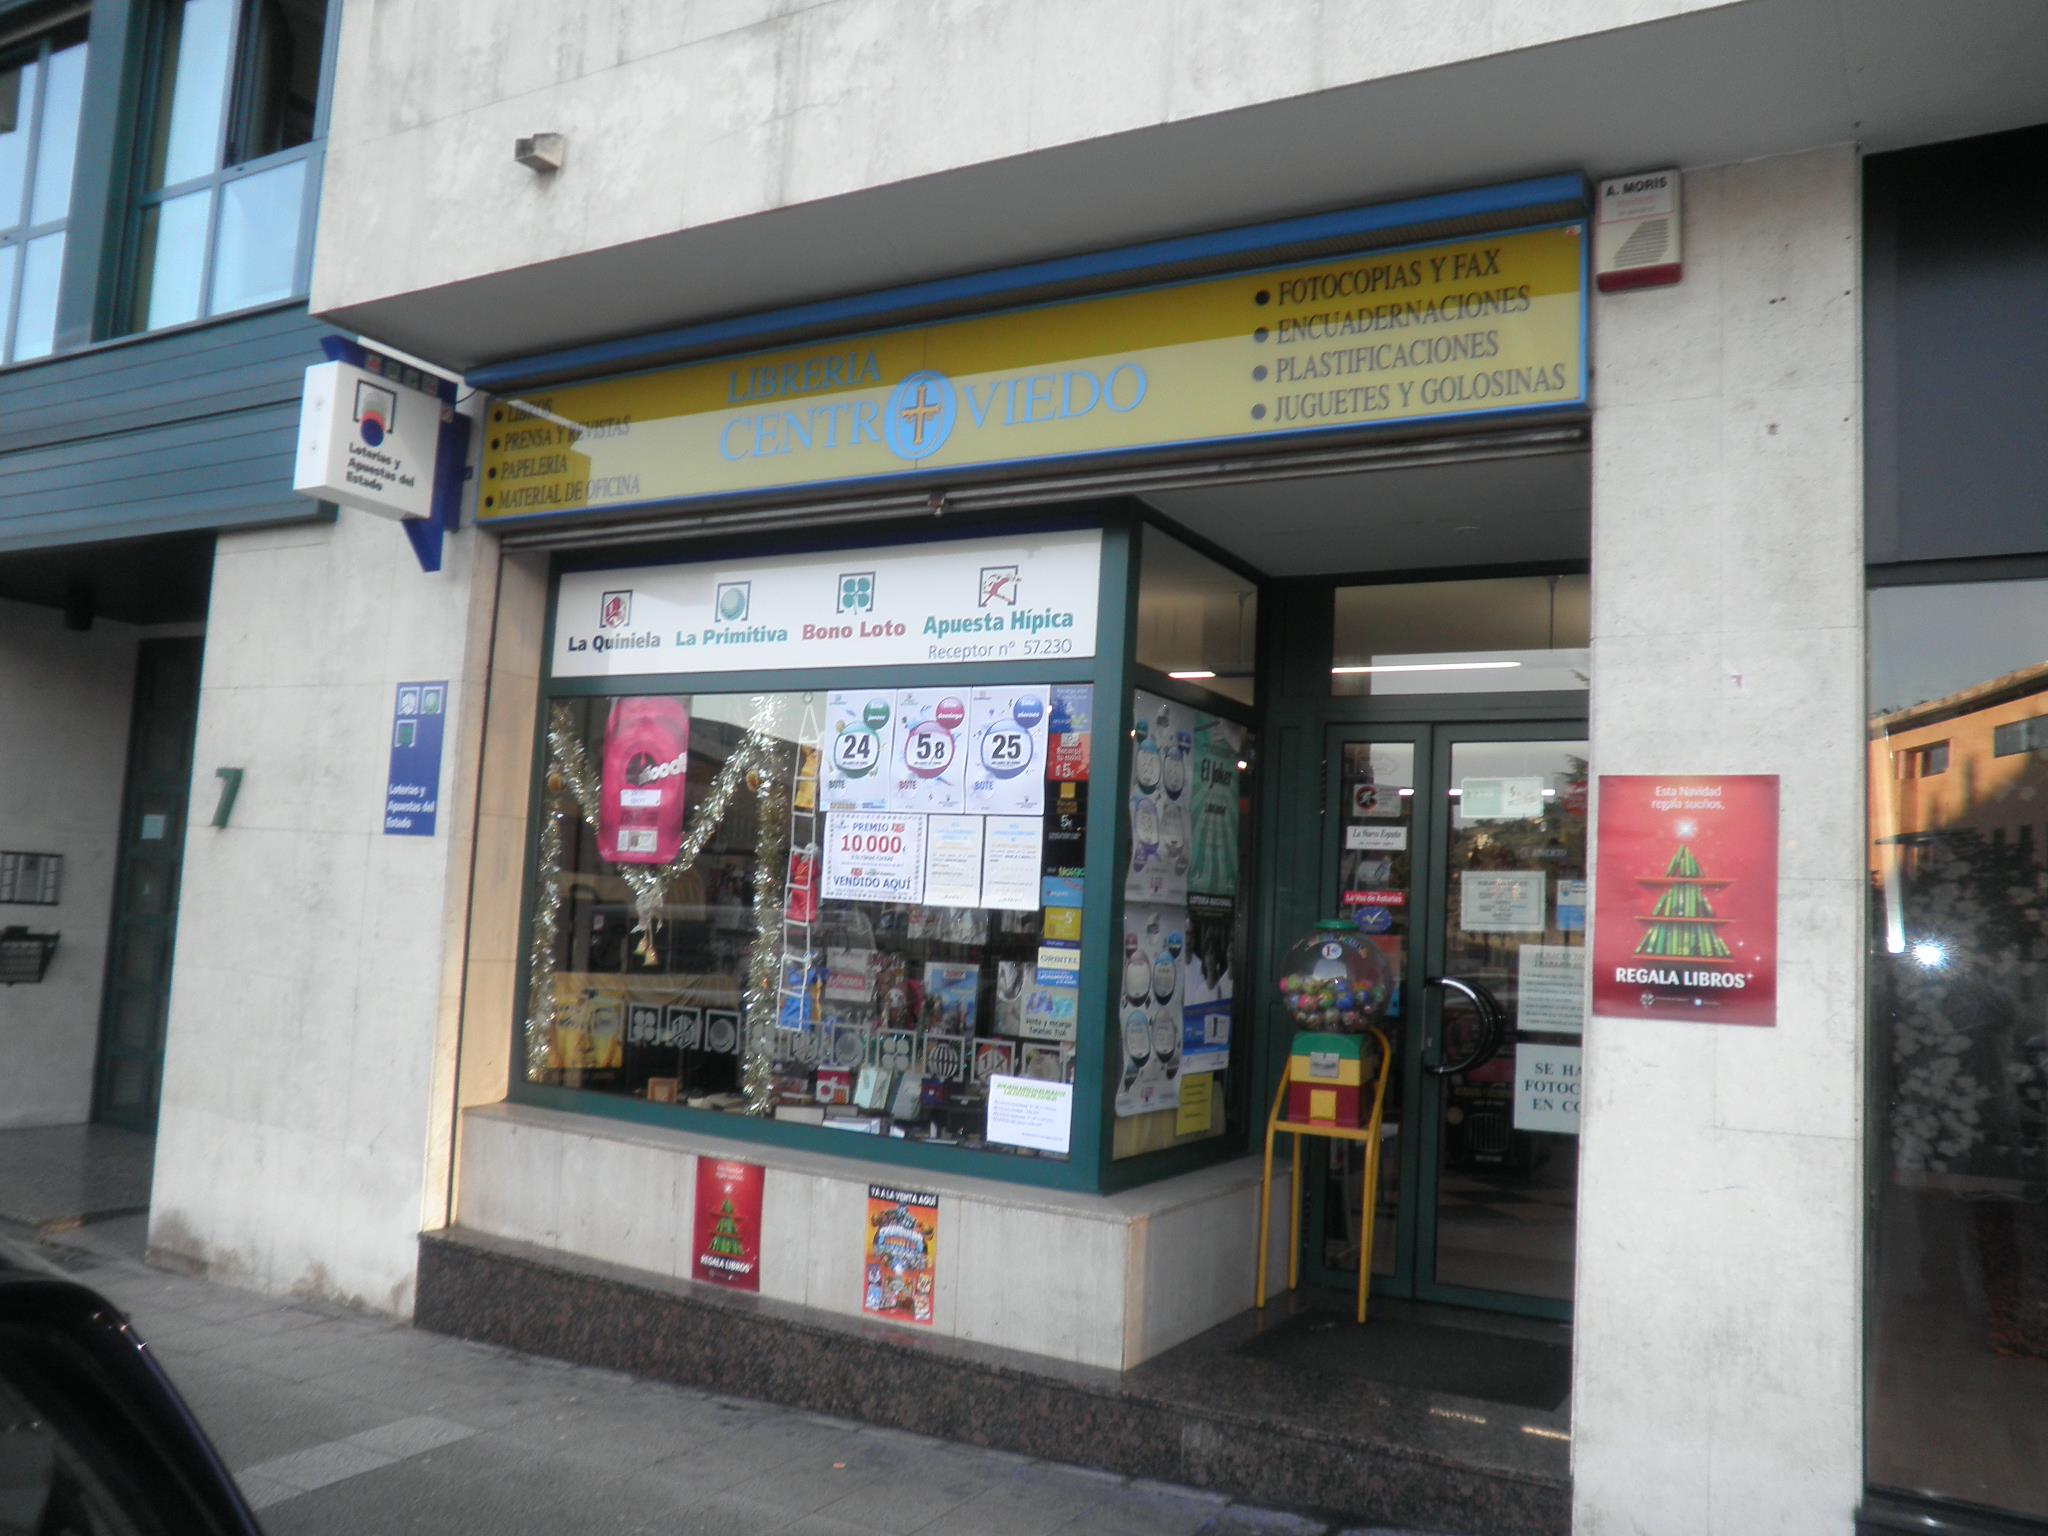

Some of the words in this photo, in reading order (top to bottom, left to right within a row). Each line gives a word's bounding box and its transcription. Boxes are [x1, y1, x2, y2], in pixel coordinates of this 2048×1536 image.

[1623, 176, 1668, 194] MORIS
[1278, 259, 1422, 307] FOTOCOPIAS
[1429, 257, 1448, 284] Y
[1452, 248, 1503, 281] FAX
[1277, 284, 1531, 345] ENCUADERNACIONES
[1275, 330, 1500, 383] PLASTIFICACIONES
[726, 350, 881, 404] LIBRERIA
[1273, 384, 1391, 424] JUGUETES
[1399, 382, 1415, 408] Y
[1421, 363, 1567, 406] GOLOSINAS
[504, 426, 553, 452] PRENSA
[555, 424, 568, 446] Y
[567, 414, 631, 444] REVISTAS
[348, 457, 396, 481] Apuestas
[399, 474, 415, 488] del
[394, 459, 401, 470] y
[500, 454, 568, 480] PAPELERIA
[346, 471, 383, 491] Estado
[498, 482, 562, 510] MATERIAL
[564, 482, 582, 502] DE
[586, 475, 641, 500] OFICINA
[801, 622, 854, 642] Bono
[860, 619, 907, 640] Loto
[923, 612, 1005, 638] Apuesta
[1010, 606, 1074, 632] Hípica
[567, 635, 587, 652] La
[591, 631, 662, 653] Quiniela
[675, 630, 698, 647] La
[702, 625, 788, 646] Primitiva
[927, 642, 994, 662] Receptor
[842, 734, 871, 760] 24
[991, 734, 1021, 760] 25
[208, 766, 245, 830] 7
[1679, 785, 1722, 797] Navidad
[386, 799, 421, 813] Apuestas
[385, 816, 412, 830] Estado
[852, 822, 889, 832] PREMIO
[833, 875, 880, 887] VENDIDO
[1615, 967, 1679, 986] REGALA
[1684, 969, 1745, 989] LIBROS
[1535, 1062, 1554, 1075] SE
[1533, 1098, 1553, 1111] EN
[886, 1189, 895, 1200] LA
[896, 1191, 917, 1204] VENTA
